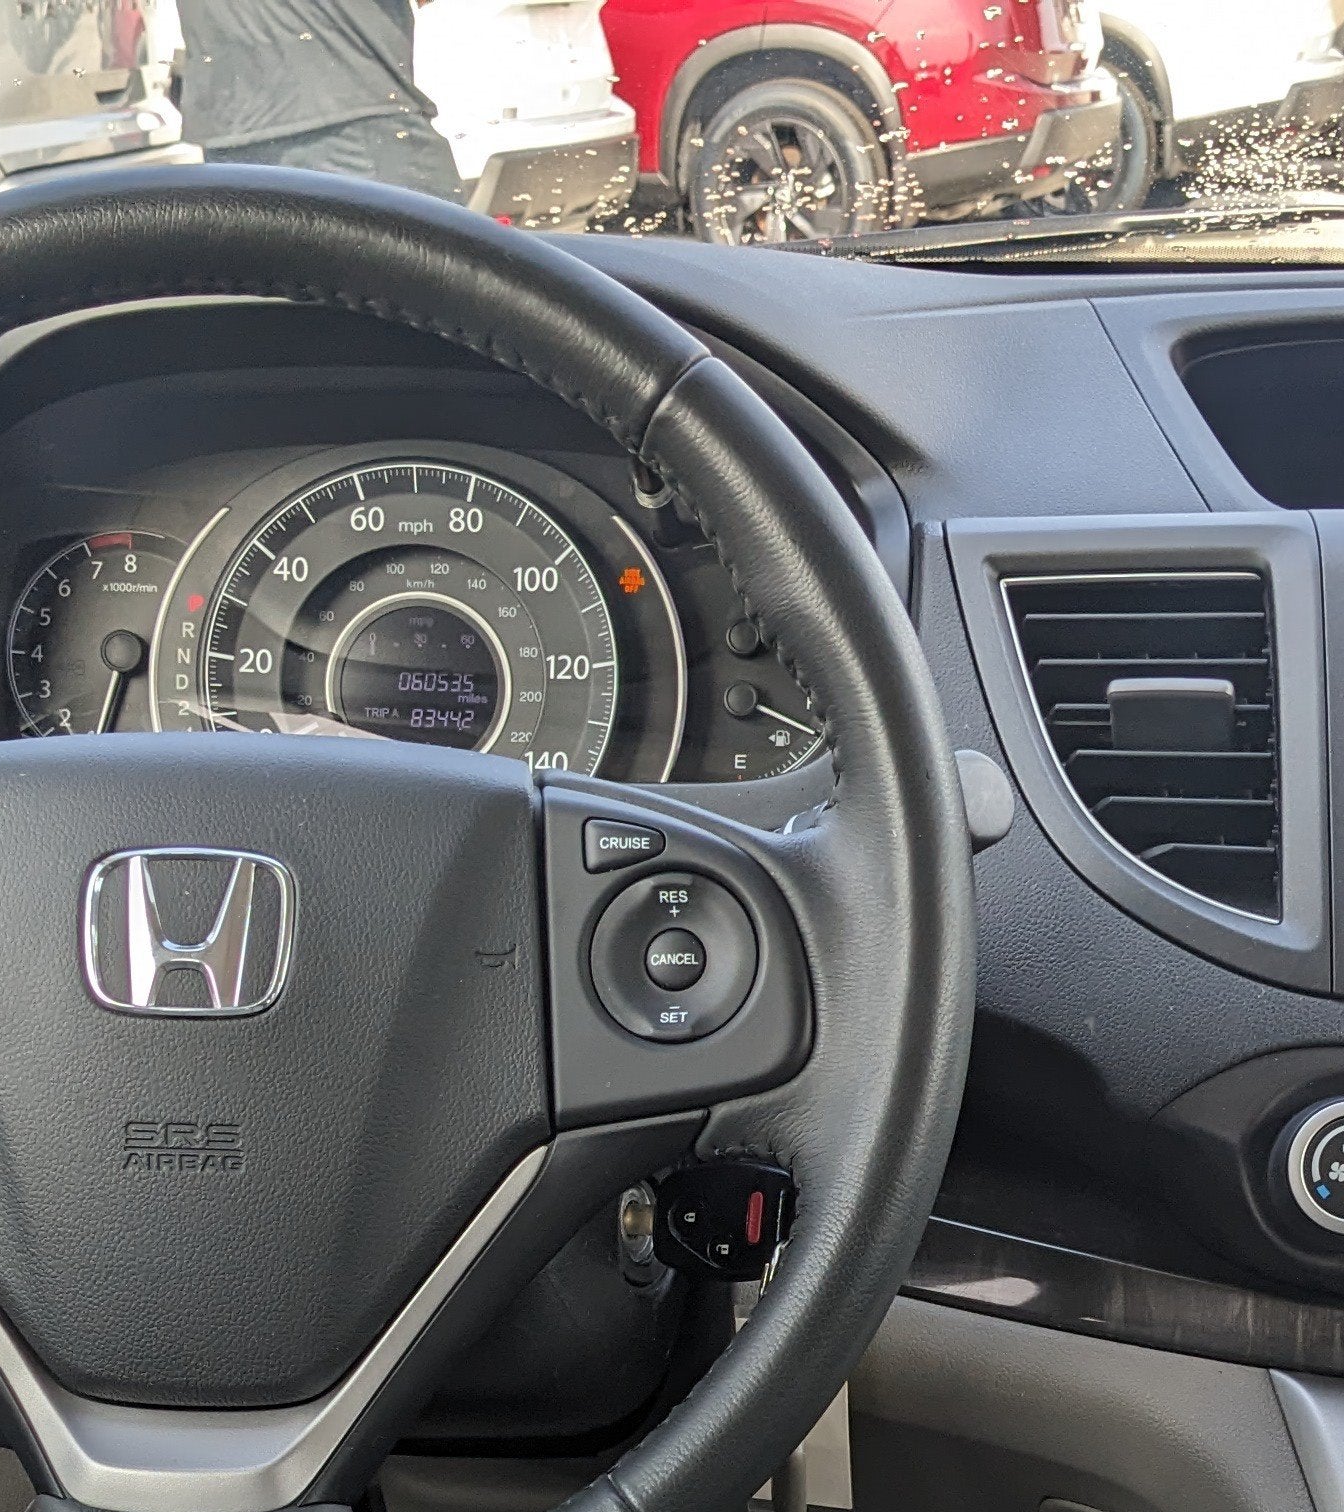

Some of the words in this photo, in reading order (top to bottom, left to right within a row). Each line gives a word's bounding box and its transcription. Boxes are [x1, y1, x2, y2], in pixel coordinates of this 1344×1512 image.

[350, 506, 385, 532] 60
[398, 519, 434, 536] mph
[448, 507, 484, 533] 80
[91, 561, 103, 580] 7
[124, 554, 137, 573] 8
[273, 556, 309, 582] 40
[386, 563, 405, 575] 100
[430, 564, 450, 575] 120
[406, 579, 435, 589] km/h
[467, 578, 487, 590] 140
[513, 566, 559, 592] 100
[58, 579, 71, 597] 6
[187, 594, 205, 612] P
[39, 608, 51, 626] 5
[498, 606, 517, 618] 160
[182, 622, 195, 638] R
[31, 644, 44, 662] 4
[177, 648, 190, 664] N
[238, 648, 273, 674] 20
[519, 647, 538, 658] 180
[546, 654, 590, 680] 120
[39, 680, 51, 698] 3
[176, 674, 188, 690] D
[398, 672, 474, 692] 060535
[457, 693, 488, 704] miles
[519, 691, 542, 702] 200
[178, 700, 190, 717] 2
[364, 707, 390, 718] TRIP
[391, 708, 400, 719] A
[59, 708, 71, 727] 2
[524, 751, 568, 772] 140
[734, 754, 747, 769] E
[599, 836, 650, 850] CRUISE
[659, 890, 688, 903] RES
[650, 953, 699, 966] CANCEL
[659, 1011, 688, 1023] SET
[124, 1122, 242, 1148] SRS
[122, 1152, 244, 1171] AIRBAG
